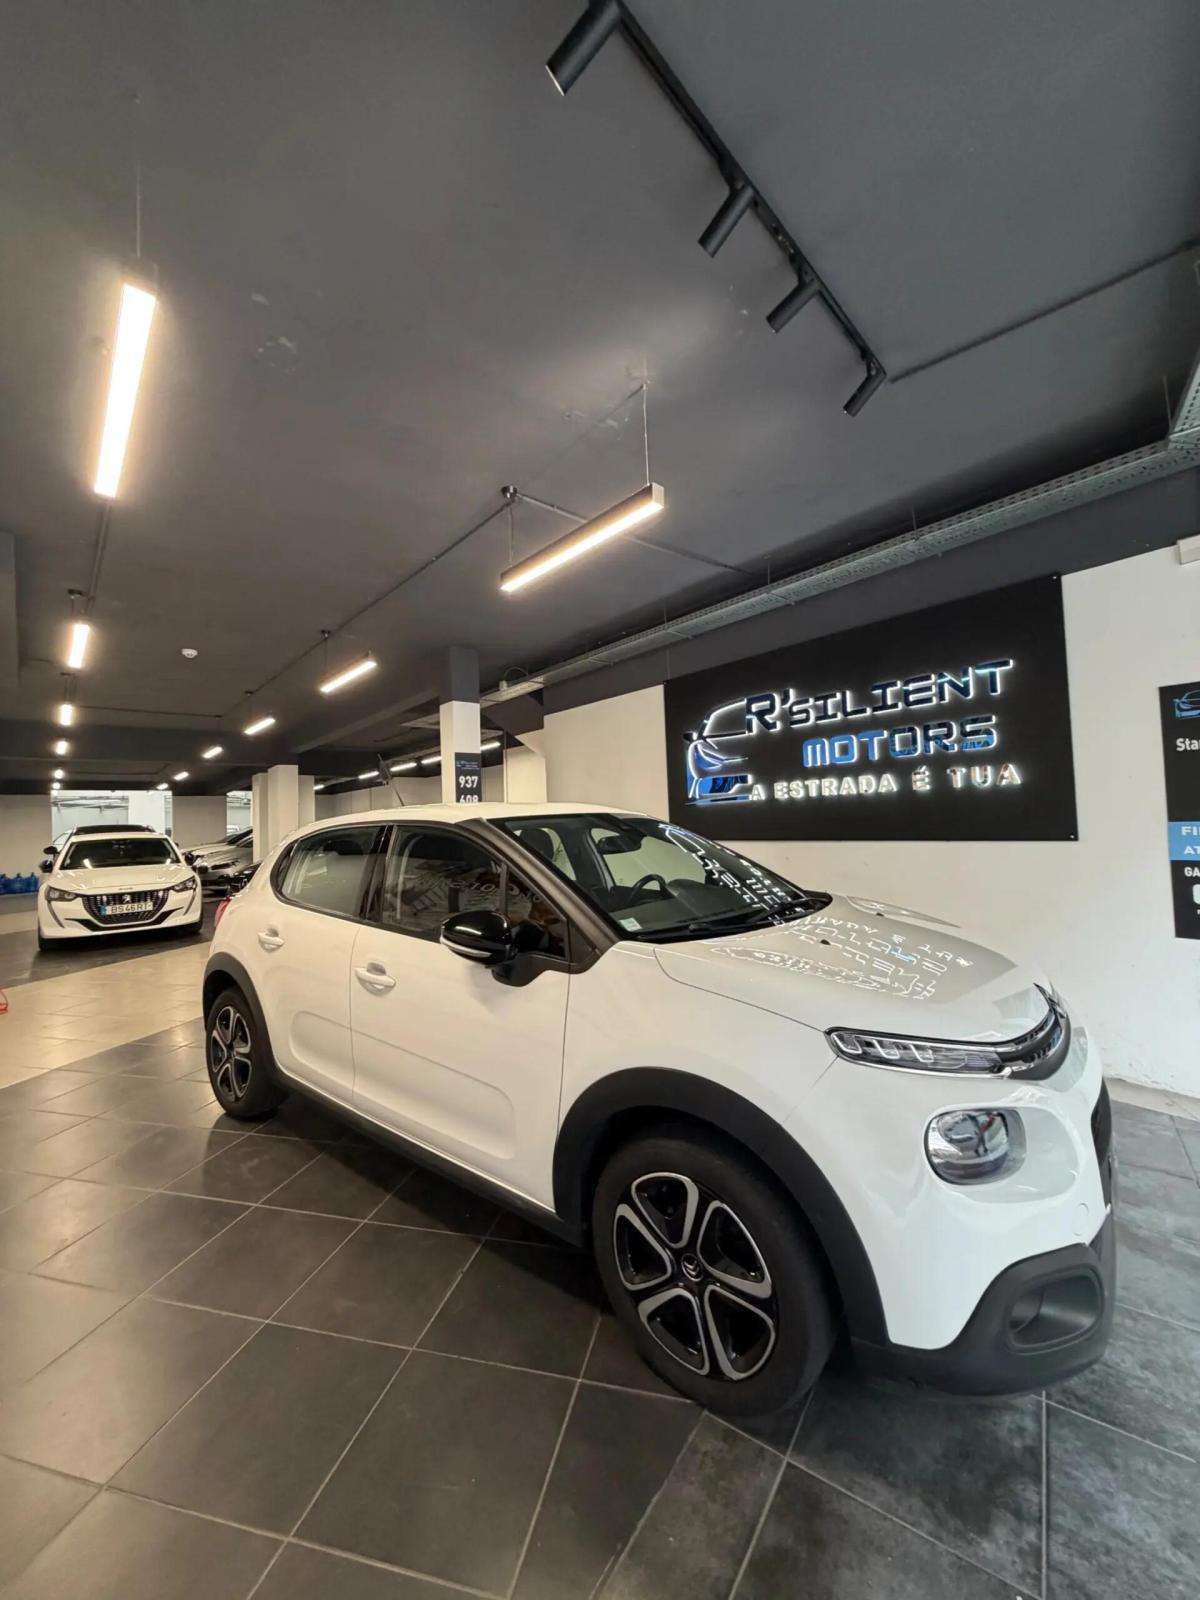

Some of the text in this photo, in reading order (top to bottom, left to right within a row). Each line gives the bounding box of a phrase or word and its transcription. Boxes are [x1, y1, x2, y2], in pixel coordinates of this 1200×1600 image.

[745, 658, 1014, 735] R'SILIENT
[802, 714, 998, 768] MOTORS
[1176, 737, 1200, 751] Sta
[458, 775, 479, 788] 937
[751, 763, 1022, 801] A ESTRADA É TUA
